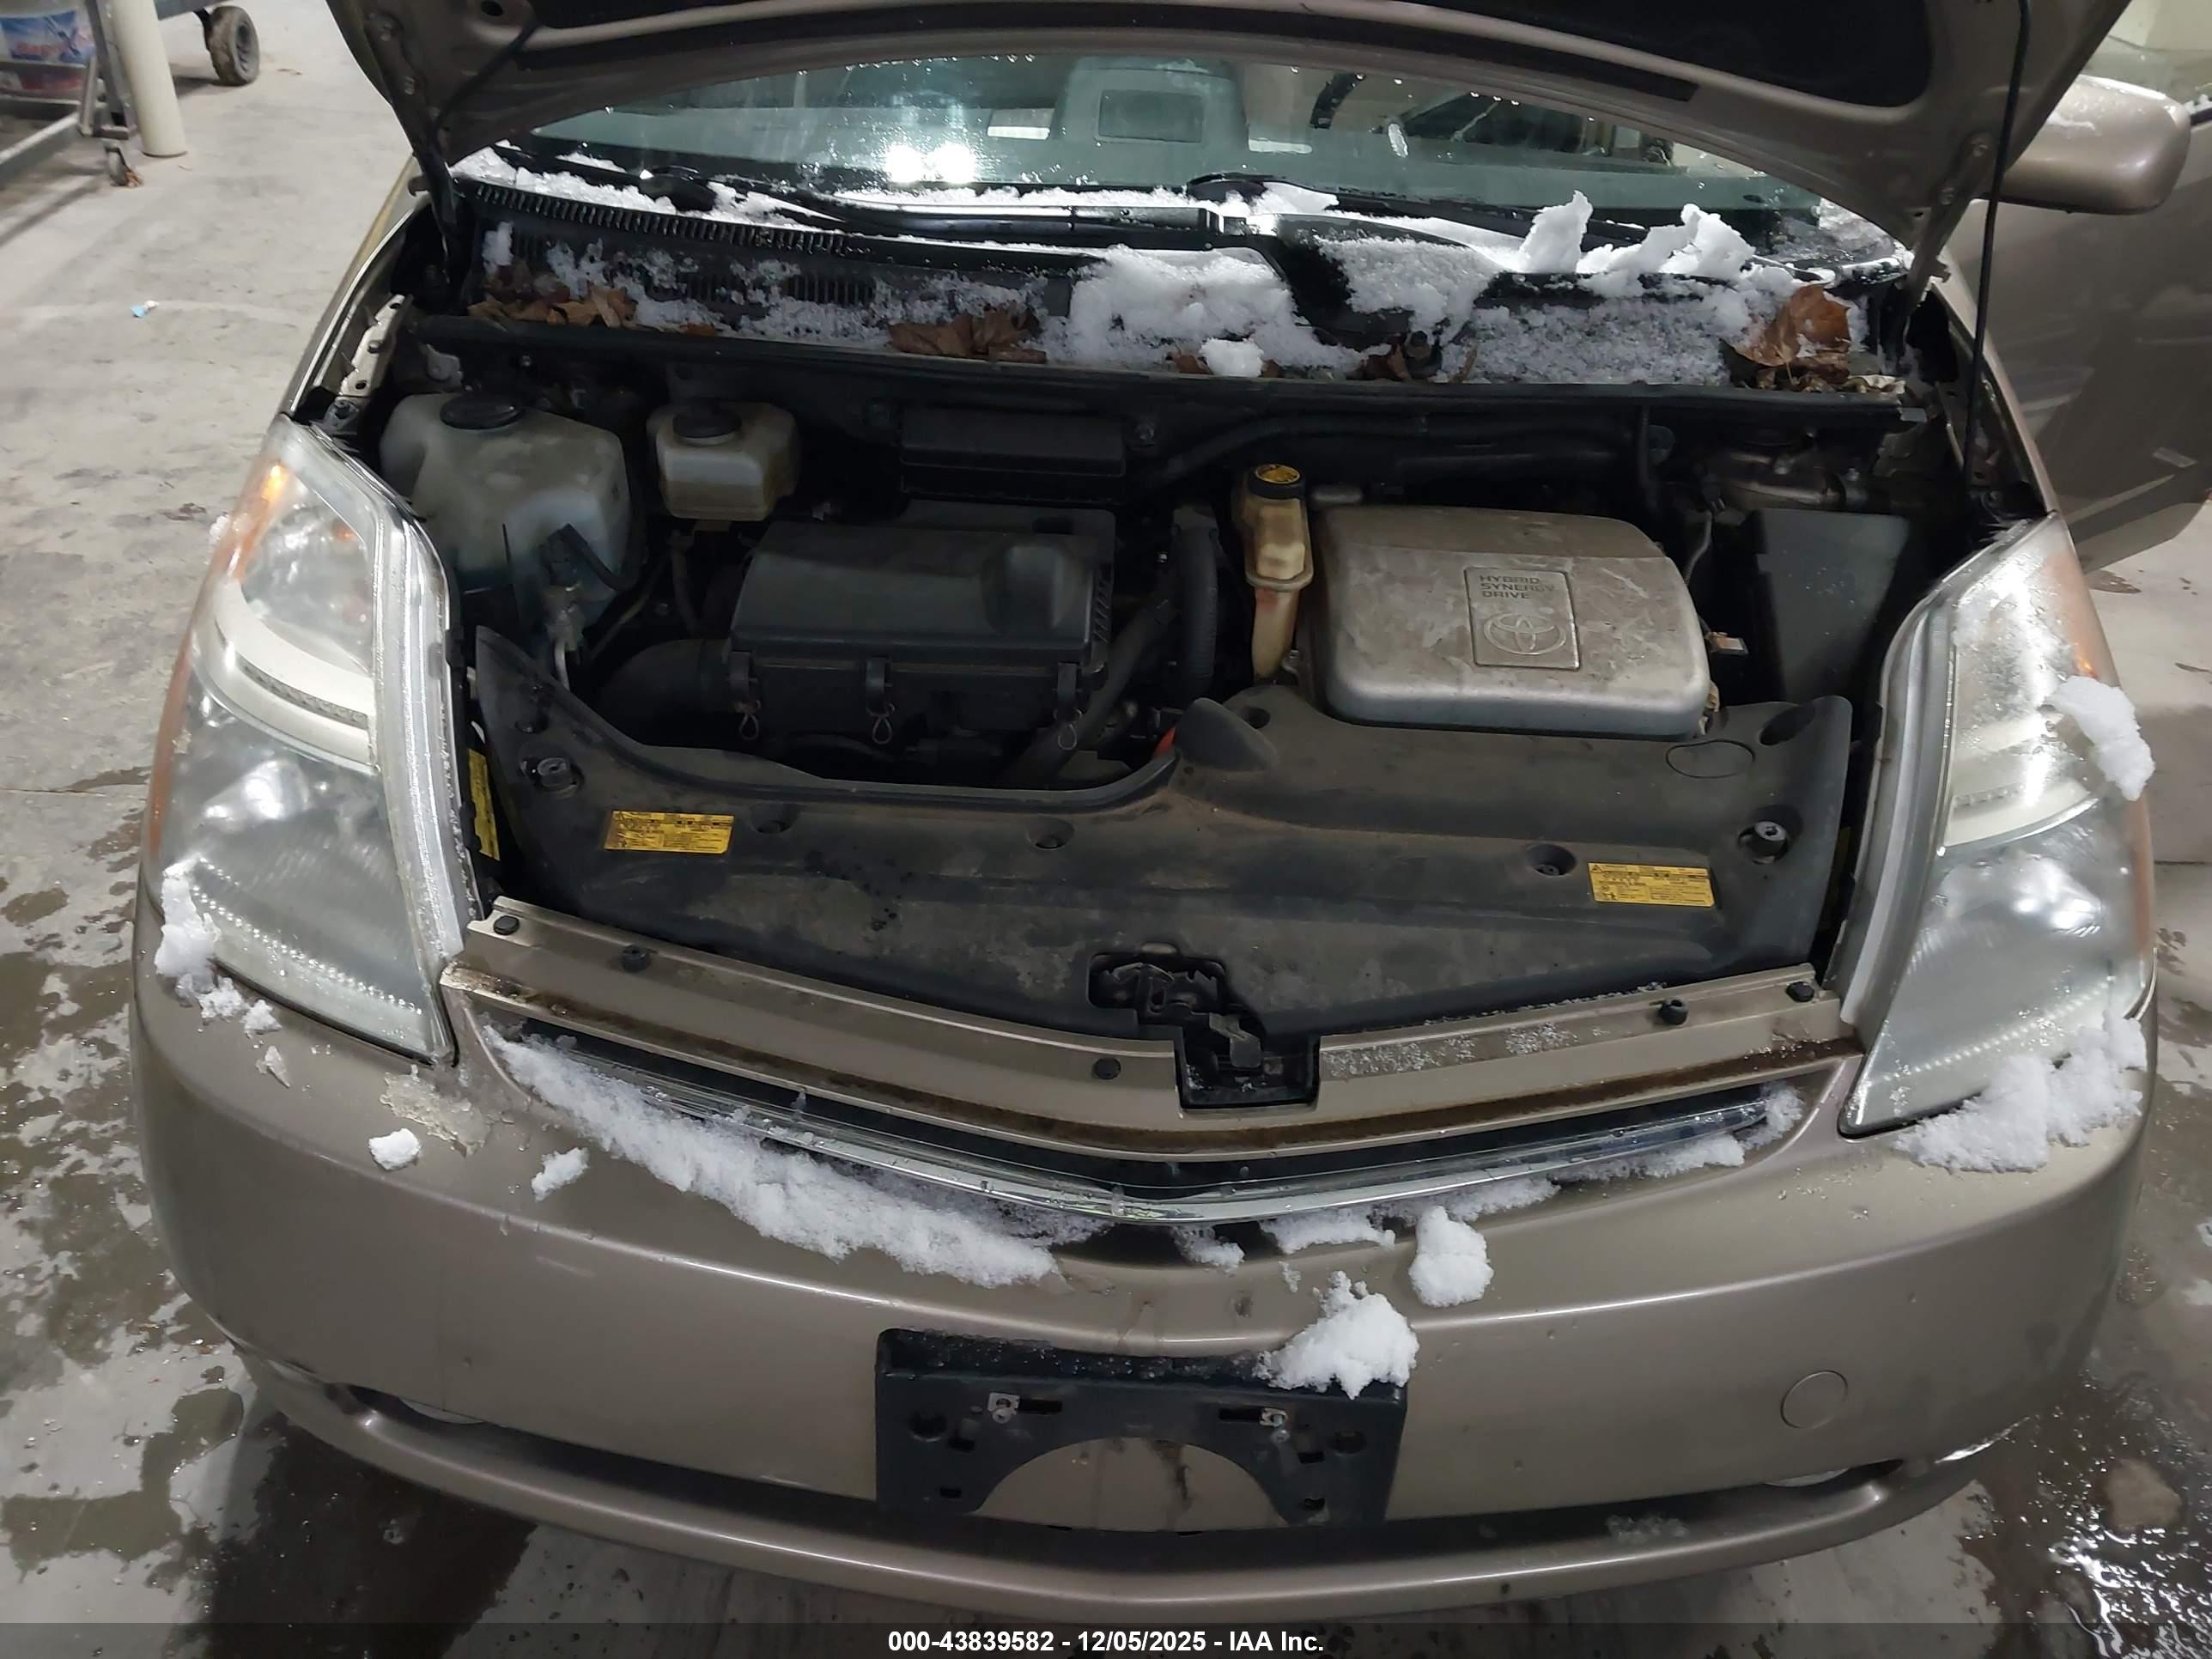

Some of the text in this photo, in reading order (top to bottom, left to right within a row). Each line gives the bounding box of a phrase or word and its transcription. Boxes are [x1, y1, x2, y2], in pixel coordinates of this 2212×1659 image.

[1480, 575, 1540, 584] HYBRID
[1481, 583, 1555, 592] SYNERGY
[1483, 591, 1531, 599] DRIVE
